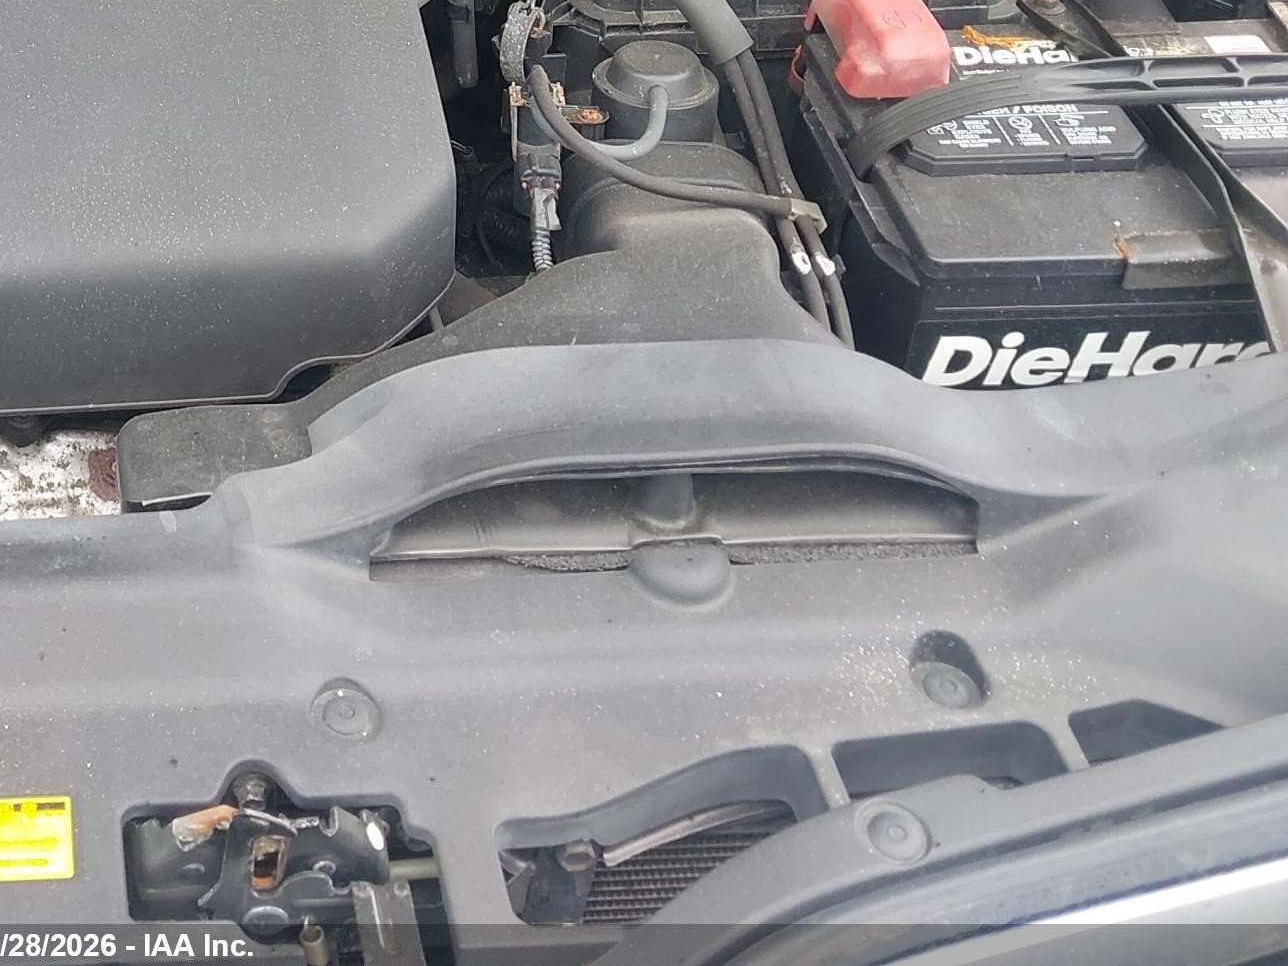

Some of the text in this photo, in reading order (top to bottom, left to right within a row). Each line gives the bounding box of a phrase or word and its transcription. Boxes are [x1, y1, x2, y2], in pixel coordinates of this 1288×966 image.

[952, 45, 1080, 66] DieHa
[1022, 104, 1078, 114] POISON
[921, 331, 1273, 386] DieHar
